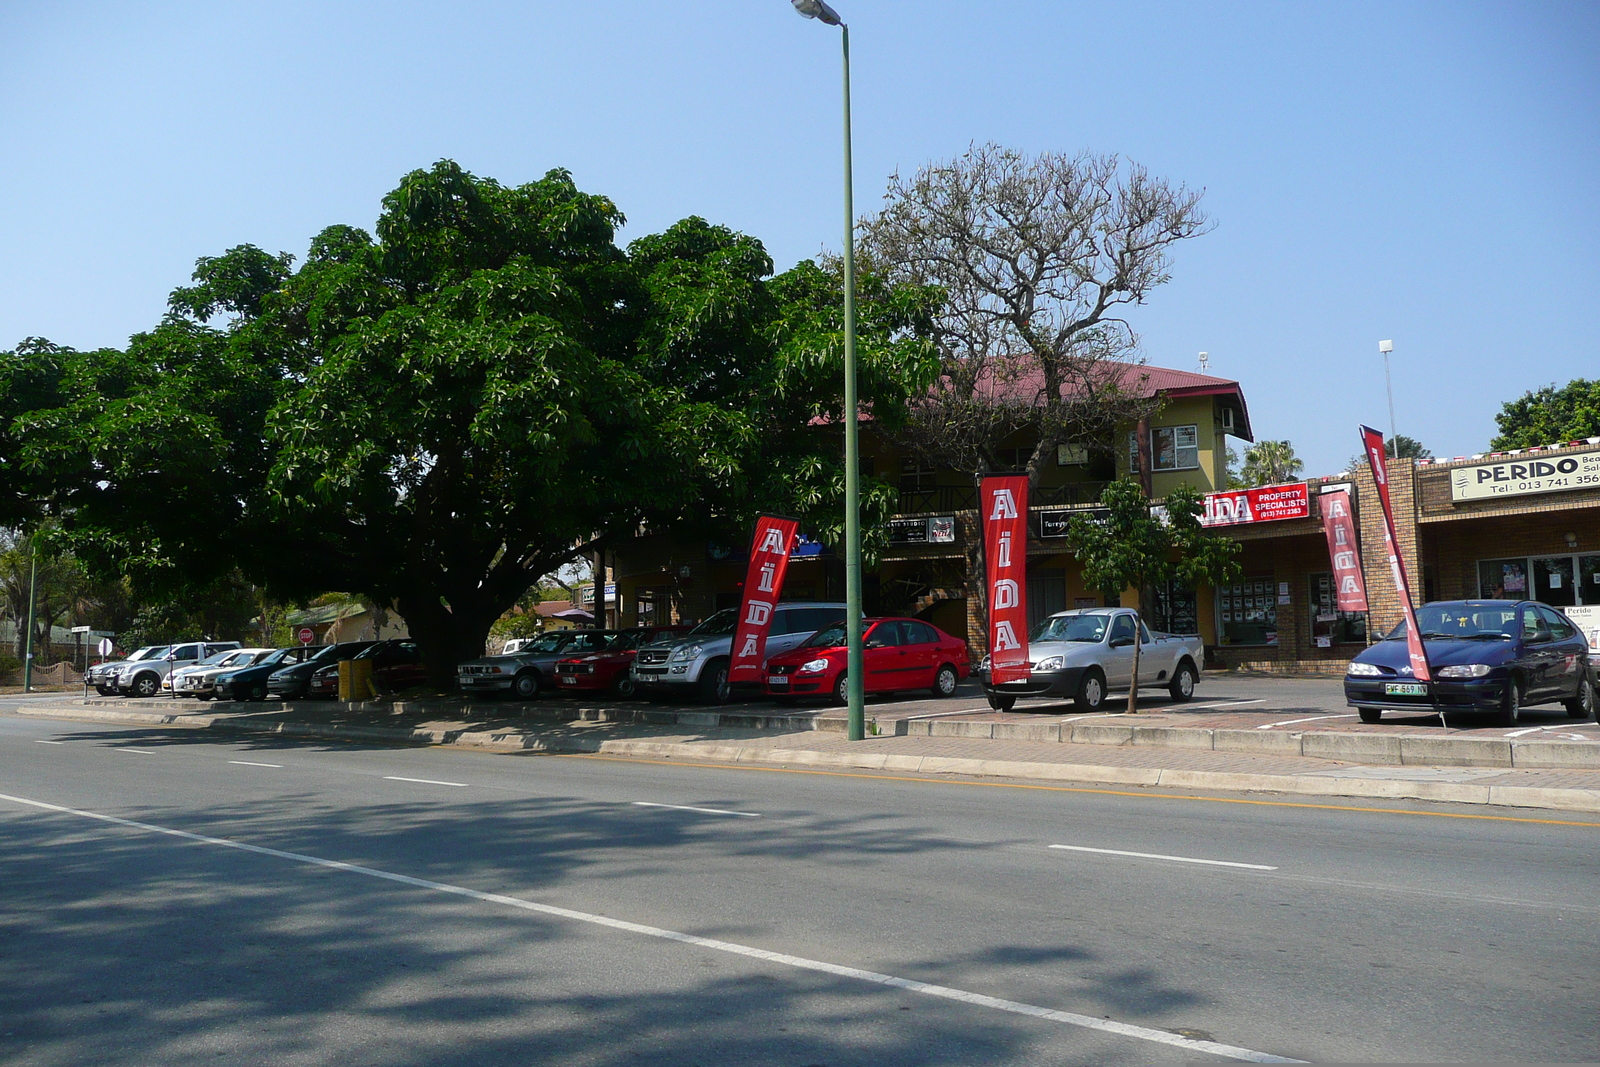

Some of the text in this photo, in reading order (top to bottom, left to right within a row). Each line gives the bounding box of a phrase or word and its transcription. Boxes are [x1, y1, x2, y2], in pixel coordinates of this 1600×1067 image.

[1477, 458, 1578, 484] PERIDO
[1583, 464, 1600, 472] Sal
[1490, 474, 1600, 493] Tel: 013 741 356
[1259, 490, 1301, 502] PROPERTY
[1255, 499, 1306, 511] SPECIALISTS
[1260, 511, 1275, 519] (013)
